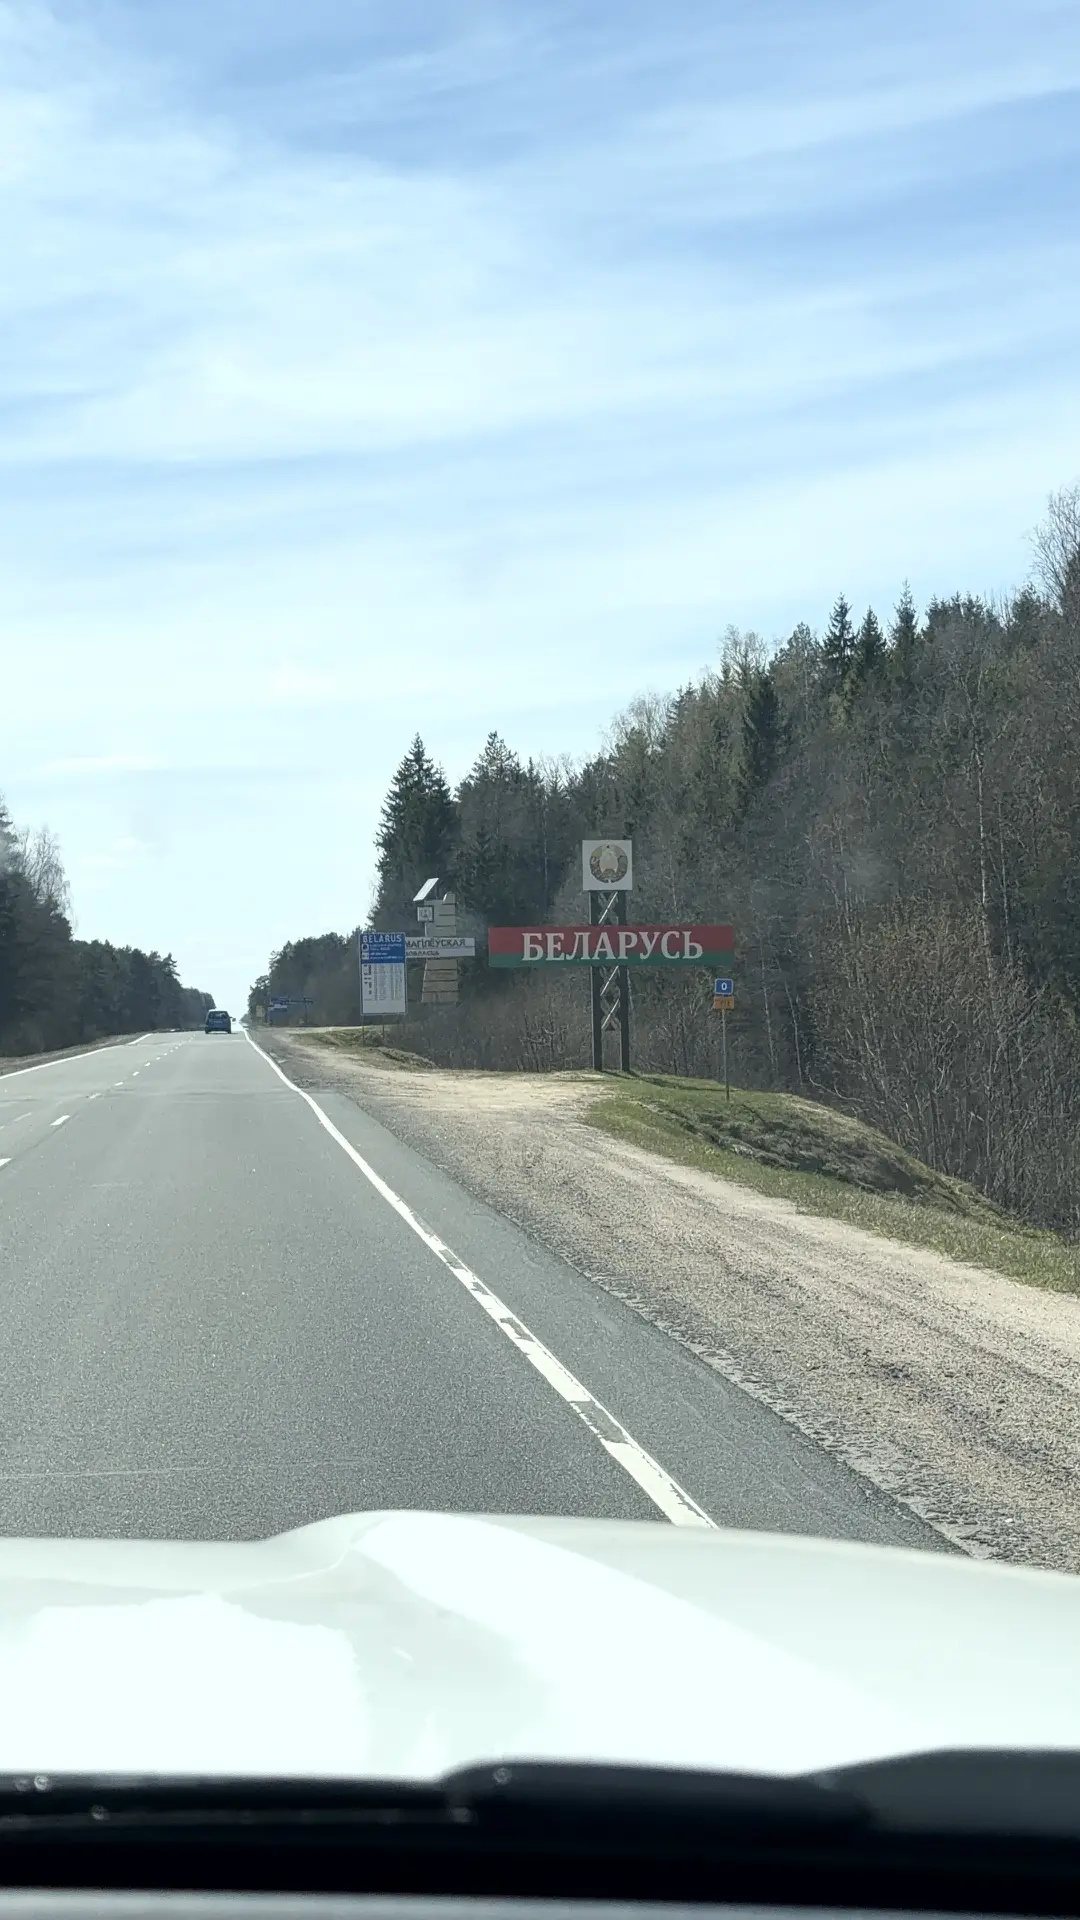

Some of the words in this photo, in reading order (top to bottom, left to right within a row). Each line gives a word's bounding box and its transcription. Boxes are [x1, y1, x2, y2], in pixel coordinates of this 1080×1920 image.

[362, 934, 402, 943] BELARUS
[521, 931, 704, 961] БЕЛАРУСЬ
[721, 982, 728, 991] 0
